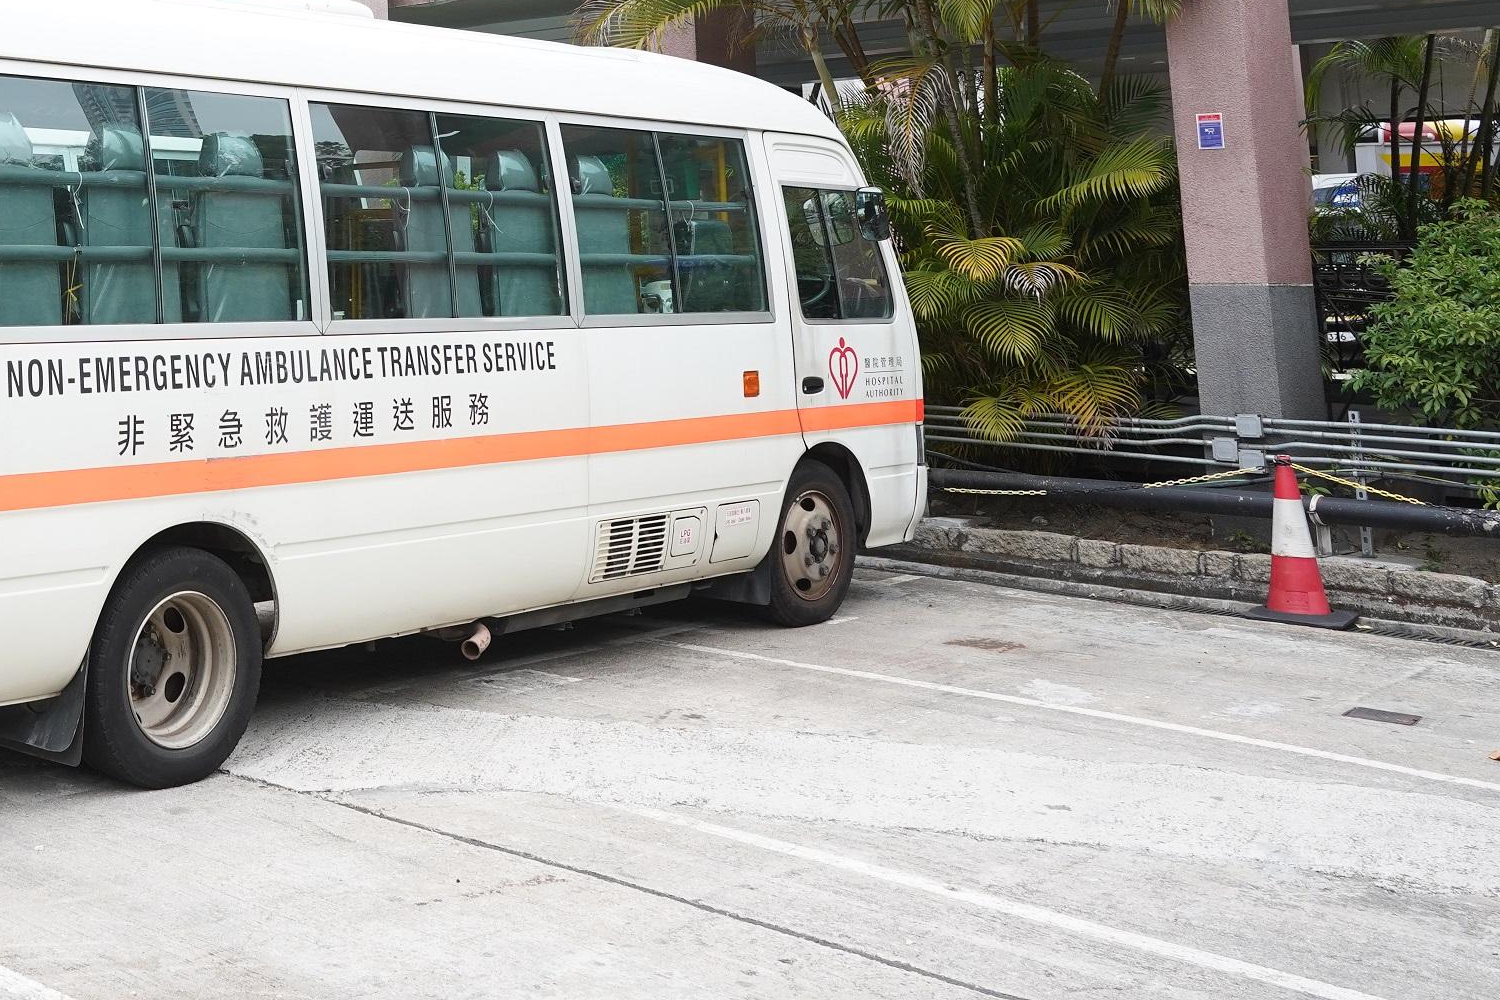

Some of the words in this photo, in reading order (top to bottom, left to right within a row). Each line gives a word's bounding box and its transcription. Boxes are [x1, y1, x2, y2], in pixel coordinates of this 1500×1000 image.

[864, 356, 903, 369] 醫院管理局
[6, 351, 231, 398] NON-EMERGENCY
[239, 346, 375, 386] AMBULANCE
[376, 343, 479, 377] TRANSFER
[482, 341, 557, 372] SERVICE
[865, 376, 903, 386] HOSPITAL
[866, 388, 904, 398] AUTHORITY
[117, 393, 490, 457] 非緊急救護運送服務
[680, 529, 691, 538] LPG
